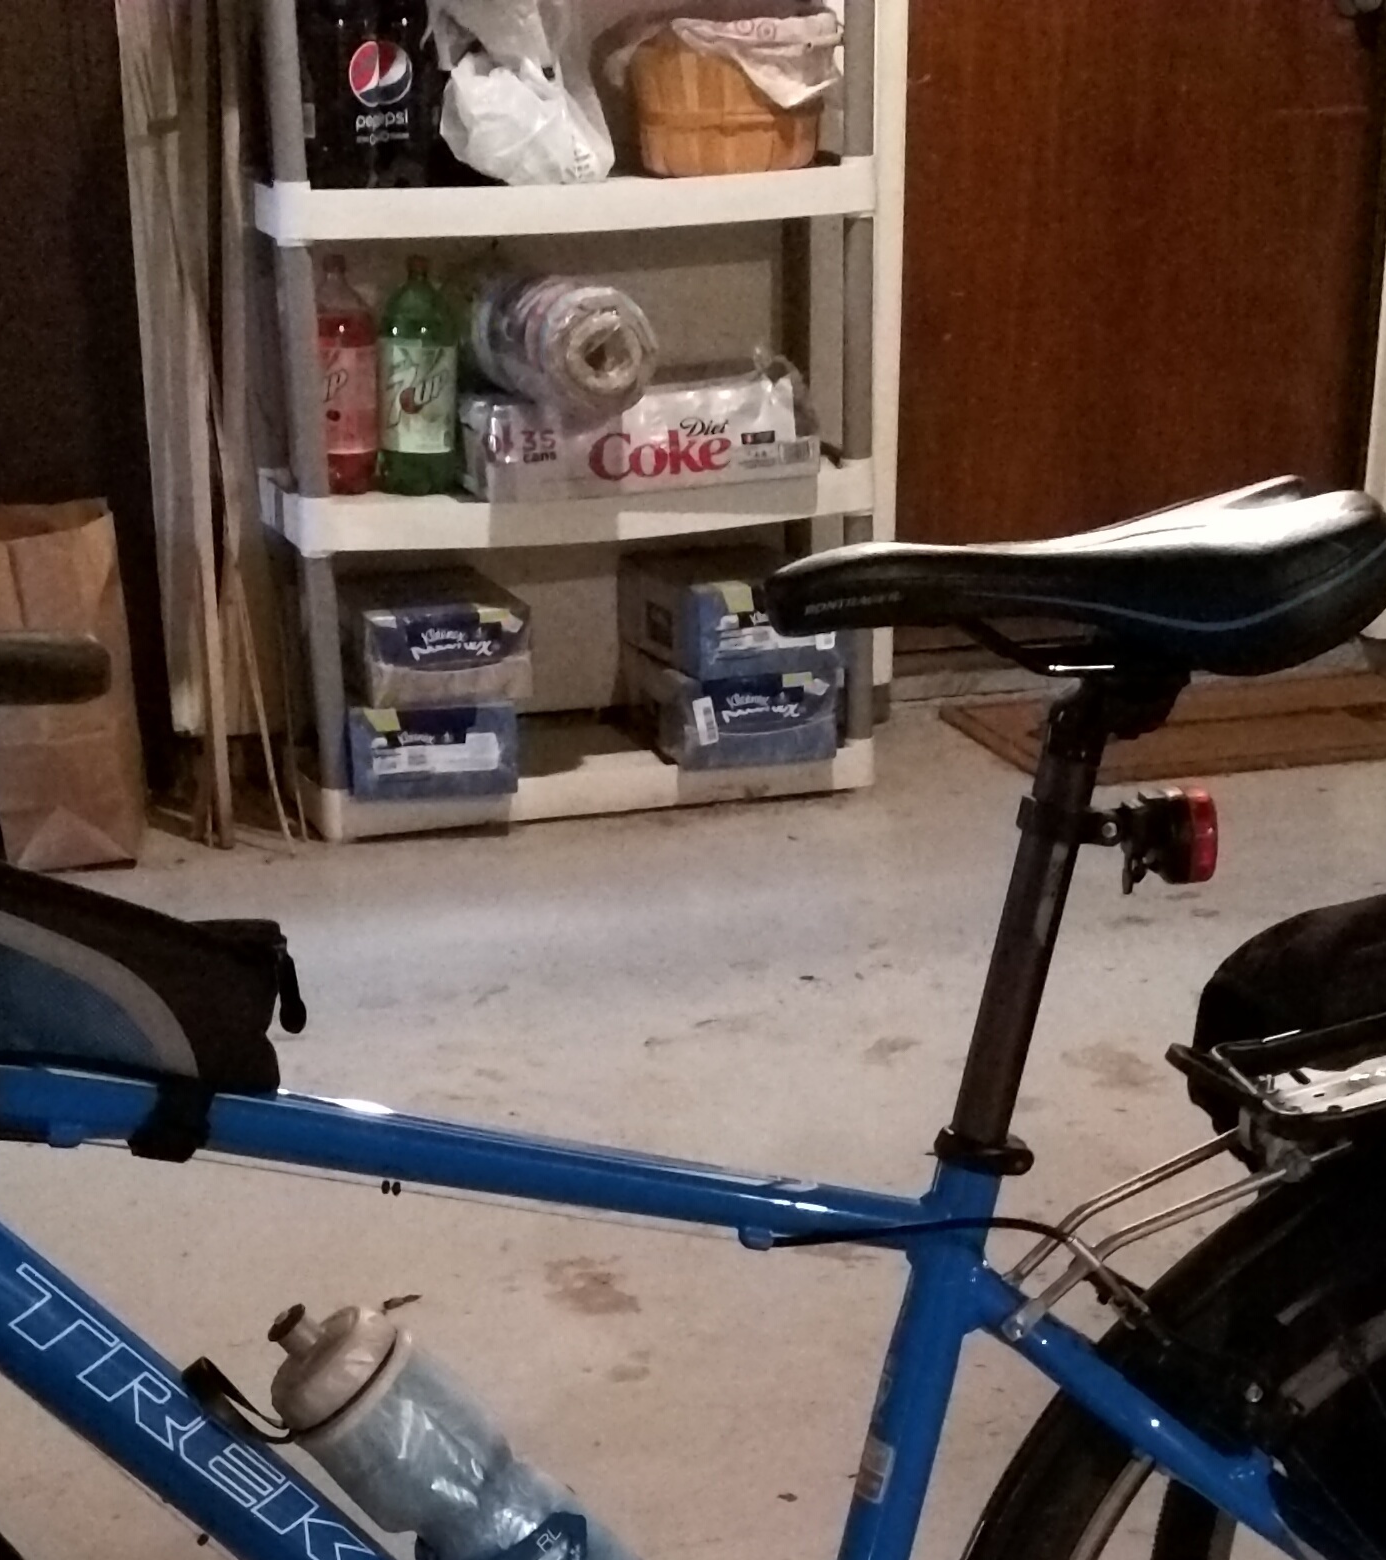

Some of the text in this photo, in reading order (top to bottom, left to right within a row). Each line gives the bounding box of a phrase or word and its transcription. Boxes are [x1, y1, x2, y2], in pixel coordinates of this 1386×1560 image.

[355, 109, 409, 132] pepsi
[680, 417, 730, 437] Diet
[521, 430, 556, 452] 35
[588, 420, 733, 482] Coke
[523, 451, 557, 464] cans
